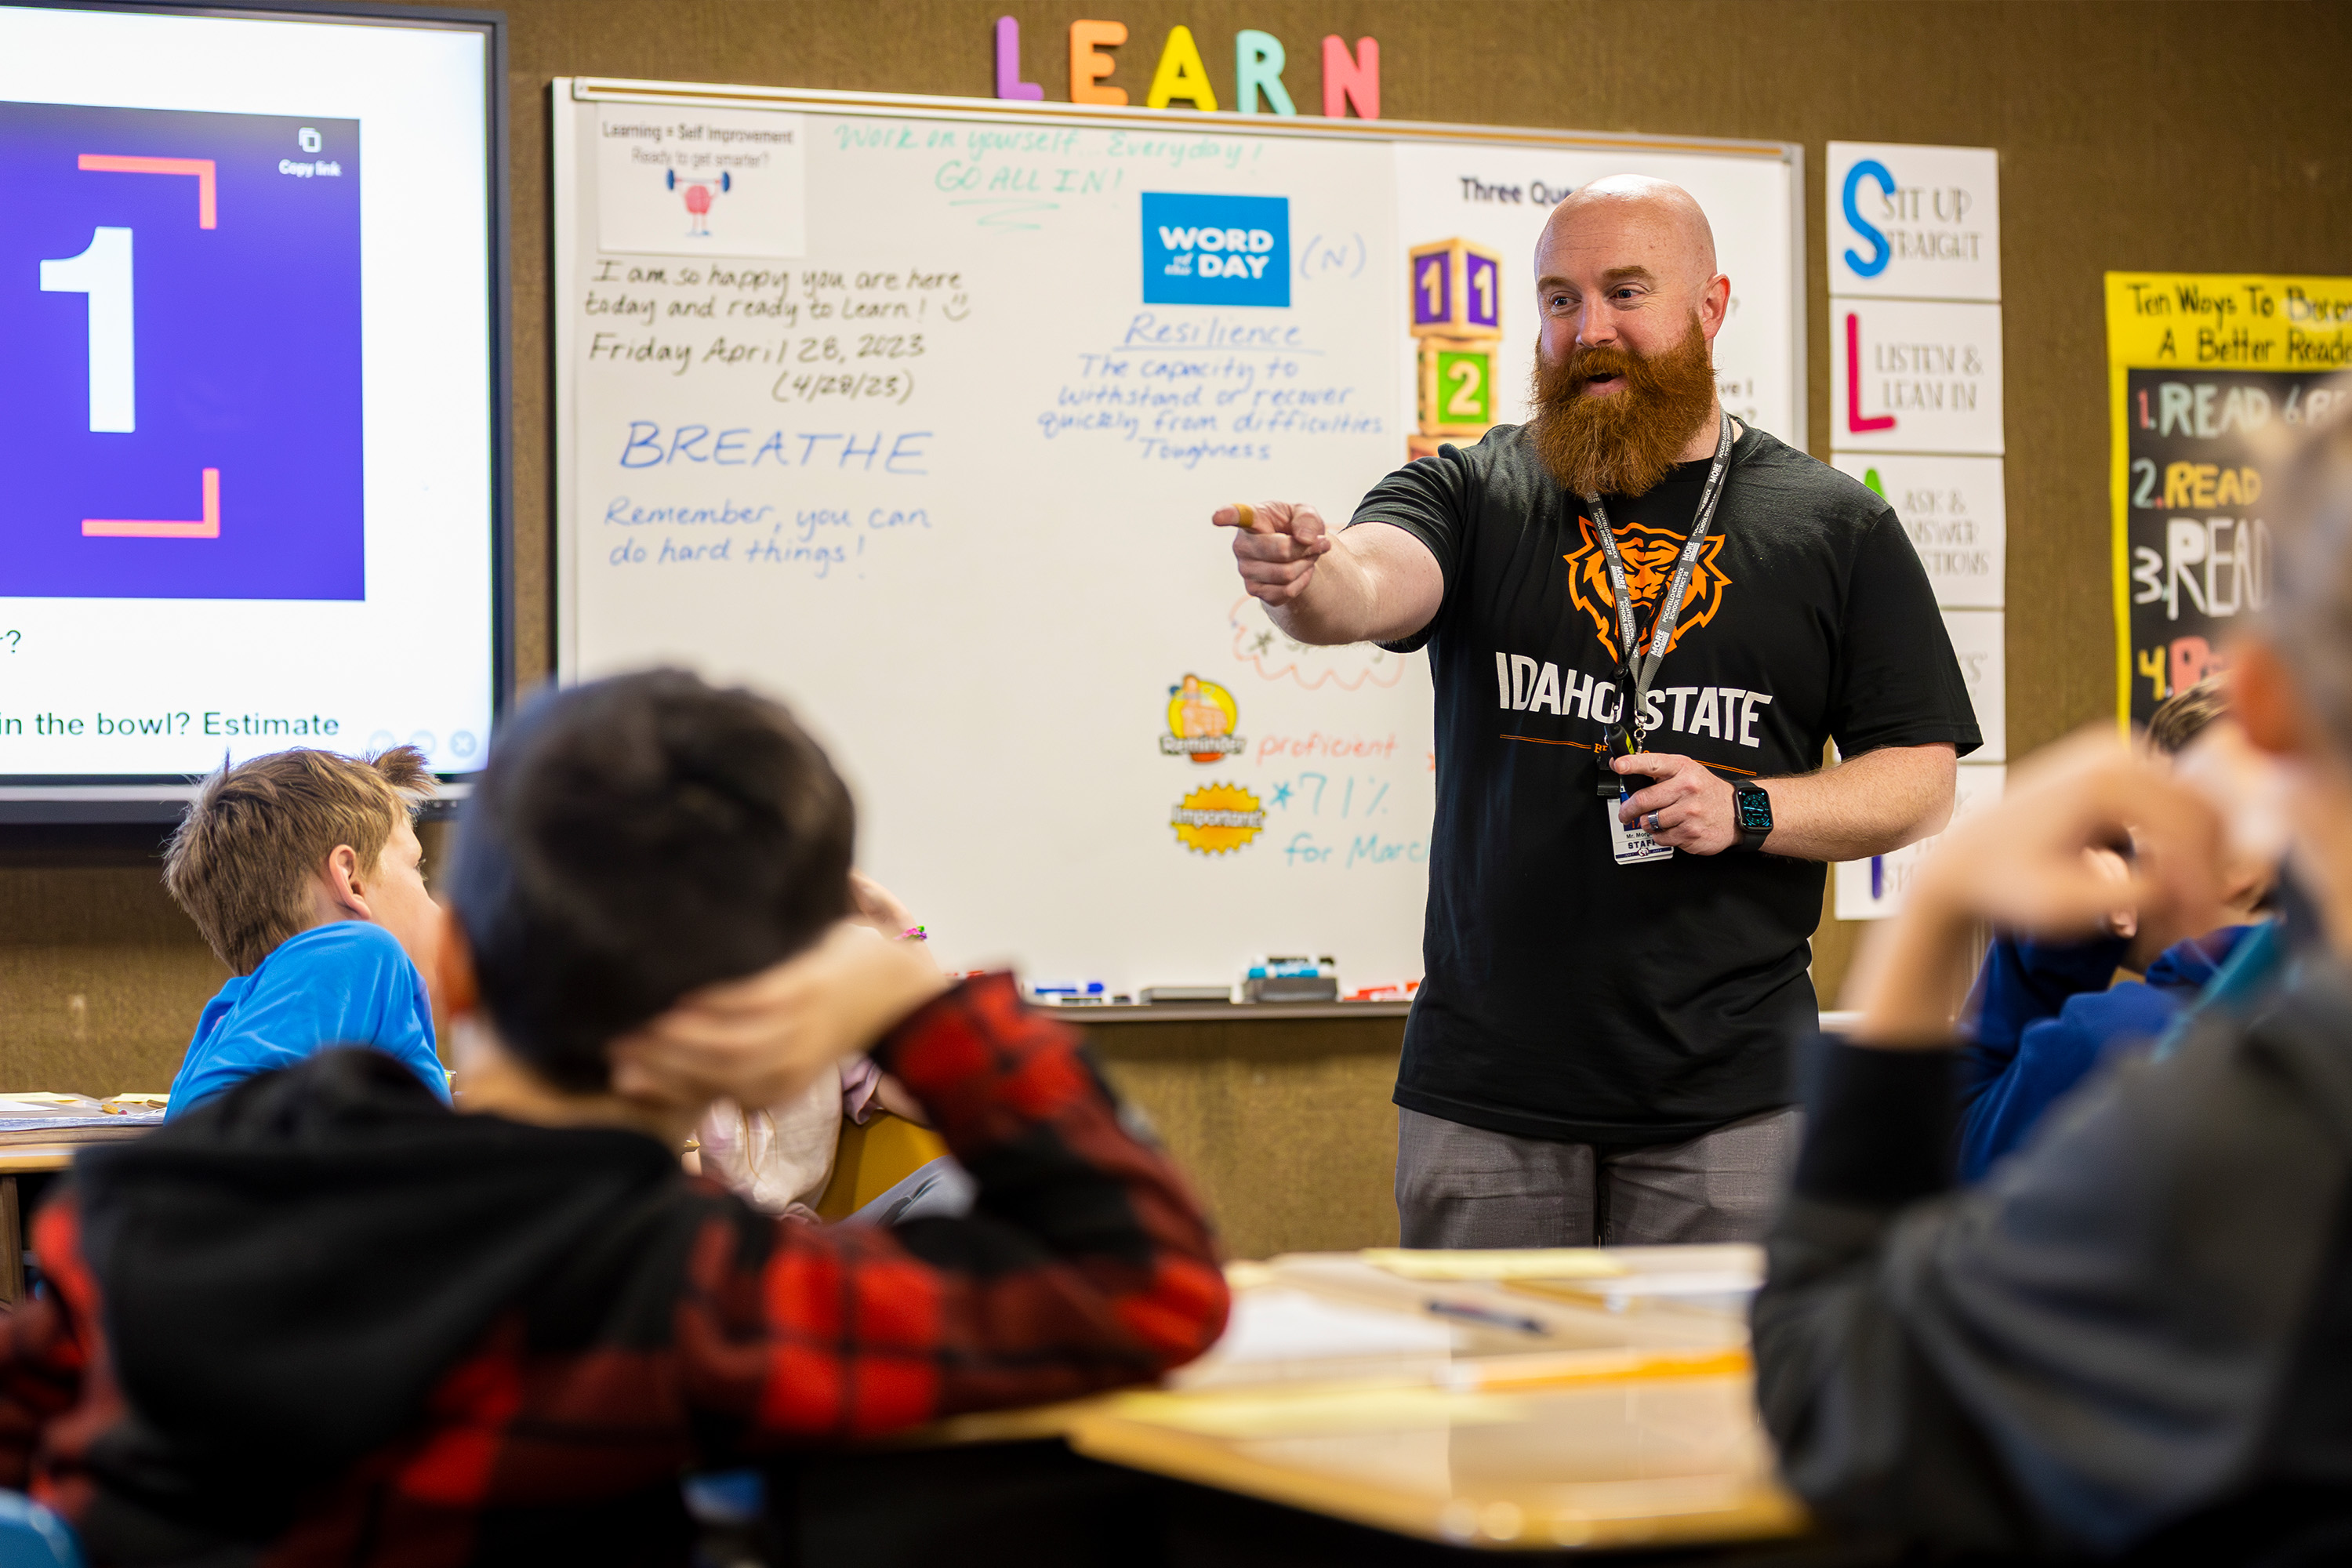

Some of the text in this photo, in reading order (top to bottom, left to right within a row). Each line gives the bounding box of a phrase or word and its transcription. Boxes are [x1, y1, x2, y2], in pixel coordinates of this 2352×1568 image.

[996, 16, 1380, 119] LEARN
[602, 121, 662, 143] Learning
[677, 123, 702, 139] Self
[278, 159, 342, 178] Copy link
[935, 159, 981, 192] GO
[988, 165, 1041, 191] ALL
[1460, 176, 1521, 204] Three
[1933, 188, 1973, 223] UP
[1159, 226, 1274, 252] WORD
[626, 266, 668, 284] am
[673, 266, 701, 286] so
[707, 263, 790, 297] happy
[802, 269, 847, 299] you
[855, 270, 900, 289] are
[906, 264, 962, 291] here
[1198, 253, 1269, 279] DAY
[584, 291, 656, 326] today
[667, 294, 713, 318] and
[727, 297, 798, 328] ready
[808, 297, 833, 319] to
[2126, 282, 2172, 314] Ten
[2176, 281, 2238, 332] Ways
[2242, 283, 2275, 318] To
[40, 226, 136, 433] 1
[1124, 311, 1304, 347] Resilience
[2158, 327, 2177, 360] A
[2198, 326, 2276, 363] Better
[589, 332, 693, 376] Friday
[701, 334, 787, 365] April
[856, 333, 926, 358] 2023
[1080, 352, 1299, 391] The capacity to
[1214, 390, 1244, 406] or
[1252, 387, 1355, 408] recover
[1447, 360, 1482, 416] 2
[1154, 408, 1218, 434] from
[1232, 409, 1384, 434] difficulties
[619, 419, 935, 475] BREATHE
[1138, 436, 1272, 470] Toughness
[1709, 463, 1723, 483] MORE
[604, 496, 933, 542] Remember, you can
[608, 537, 646, 565] do
[659, 537, 731, 563] hard
[1682, 540, 1695, 561] MORE
[1615, 566, 1627, 590] MORE
[1662, 567, 1685, 623] POCATELLO/CHUBBUCK
[1669, 599, 1680, 620] SCHOOL
[1676, 577, 1686, 599] DISTRICT
[1650, 629, 1664, 655] MORE
[1495, 652, 1773, 748] IDAHO STATE
[34, 712, 84, 735] the
[97, 711, 191, 735] bowl?
[203, 711, 339, 736] Estimate
[1256, 731, 1399, 767] proficient
[1283, 832, 1333, 867] for
